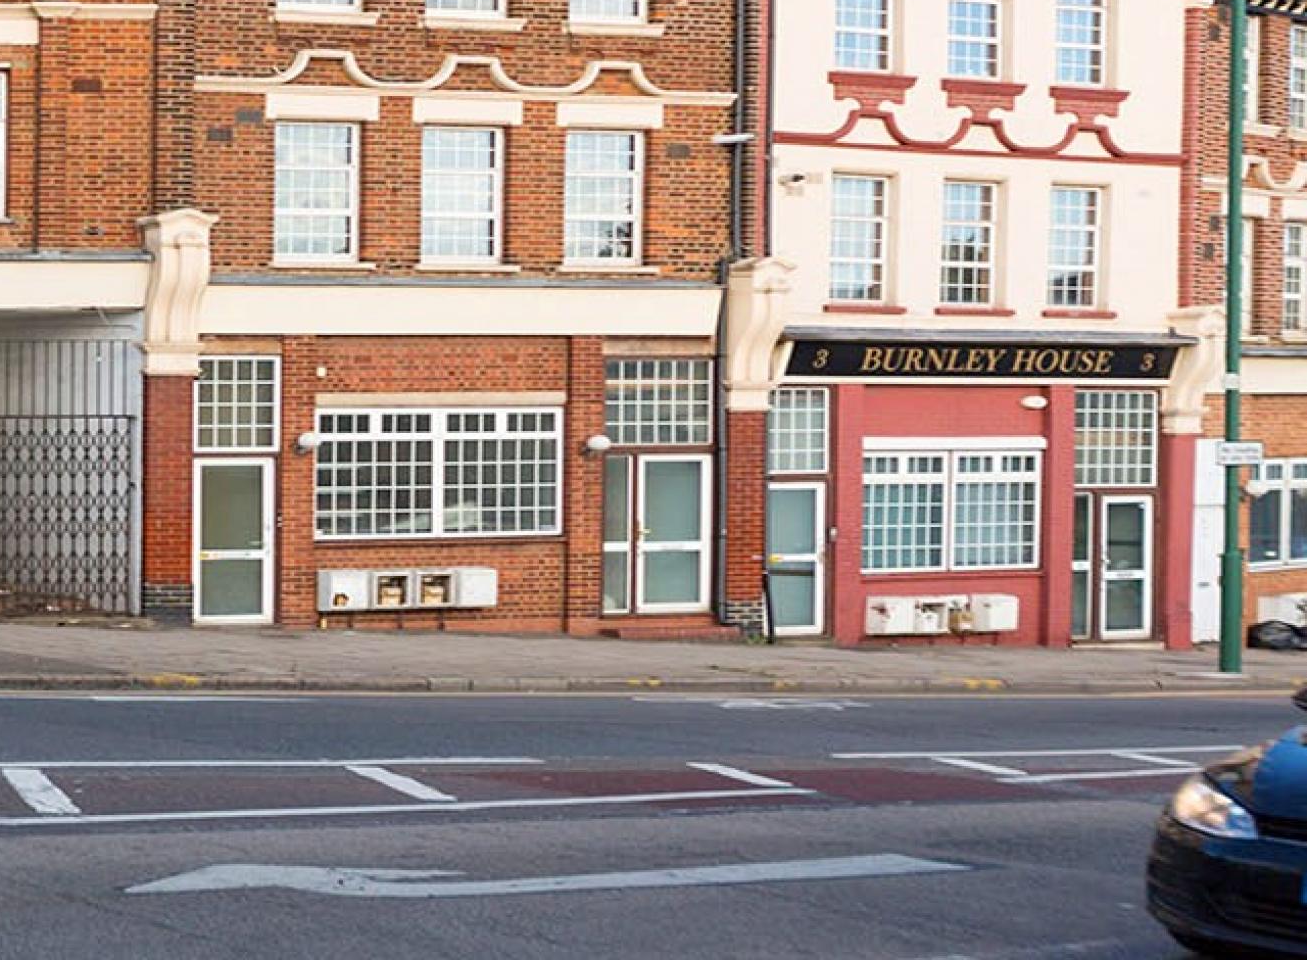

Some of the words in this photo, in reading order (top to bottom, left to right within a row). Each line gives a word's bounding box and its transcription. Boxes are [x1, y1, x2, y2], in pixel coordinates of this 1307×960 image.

[812, 349, 829, 368] 3
[860, 346, 1007, 373] BURNLEY
[1011, 348, 1115, 373] HOUSE
[1139, 352, 1155, 371] 3
